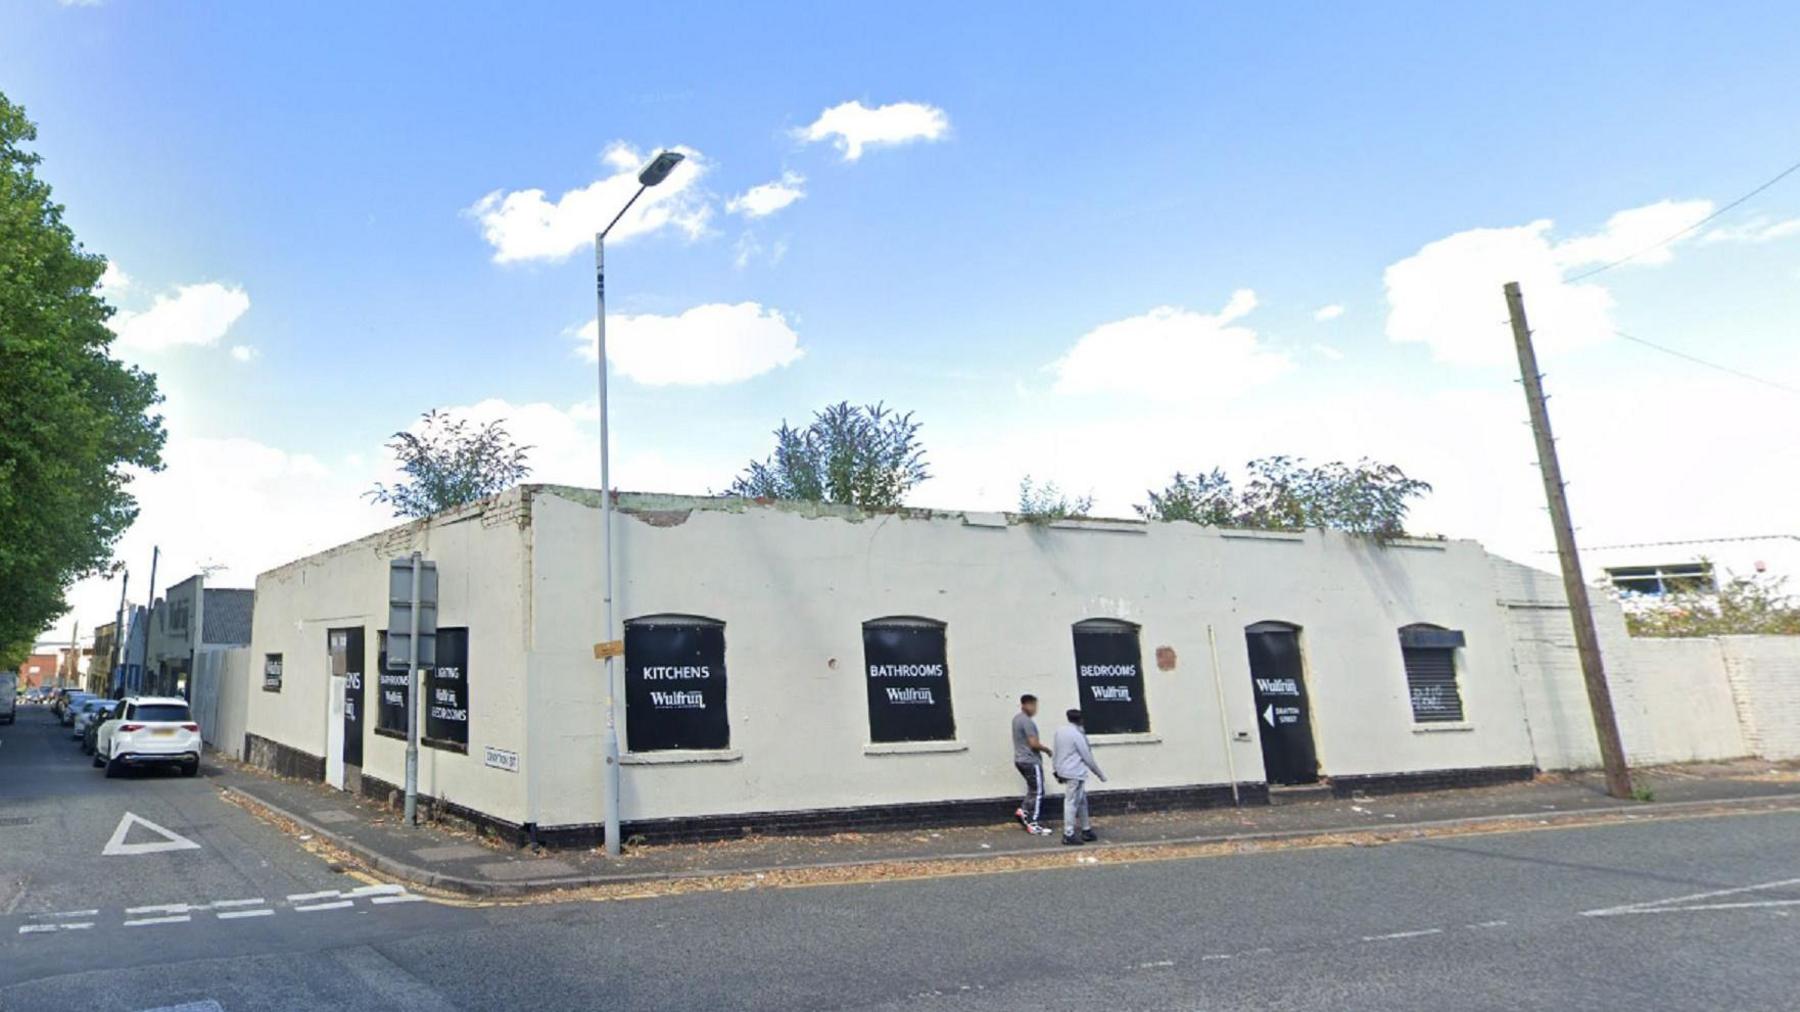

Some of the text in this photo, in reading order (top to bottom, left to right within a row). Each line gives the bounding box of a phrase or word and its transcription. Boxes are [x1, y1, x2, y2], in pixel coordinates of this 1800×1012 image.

[643, 666, 710, 680] KITCHENS
[870, 664, 943, 677] BATHROOMS
[1081, 665, 1136, 676] BEDROOMS
[1091, 686, 1132, 701] Wulfrun
[1257, 679, 1299, 696] Wulfrun
[650, 691, 706, 708] Wulfrun
[886, 687, 935, 704] Wulfrun
